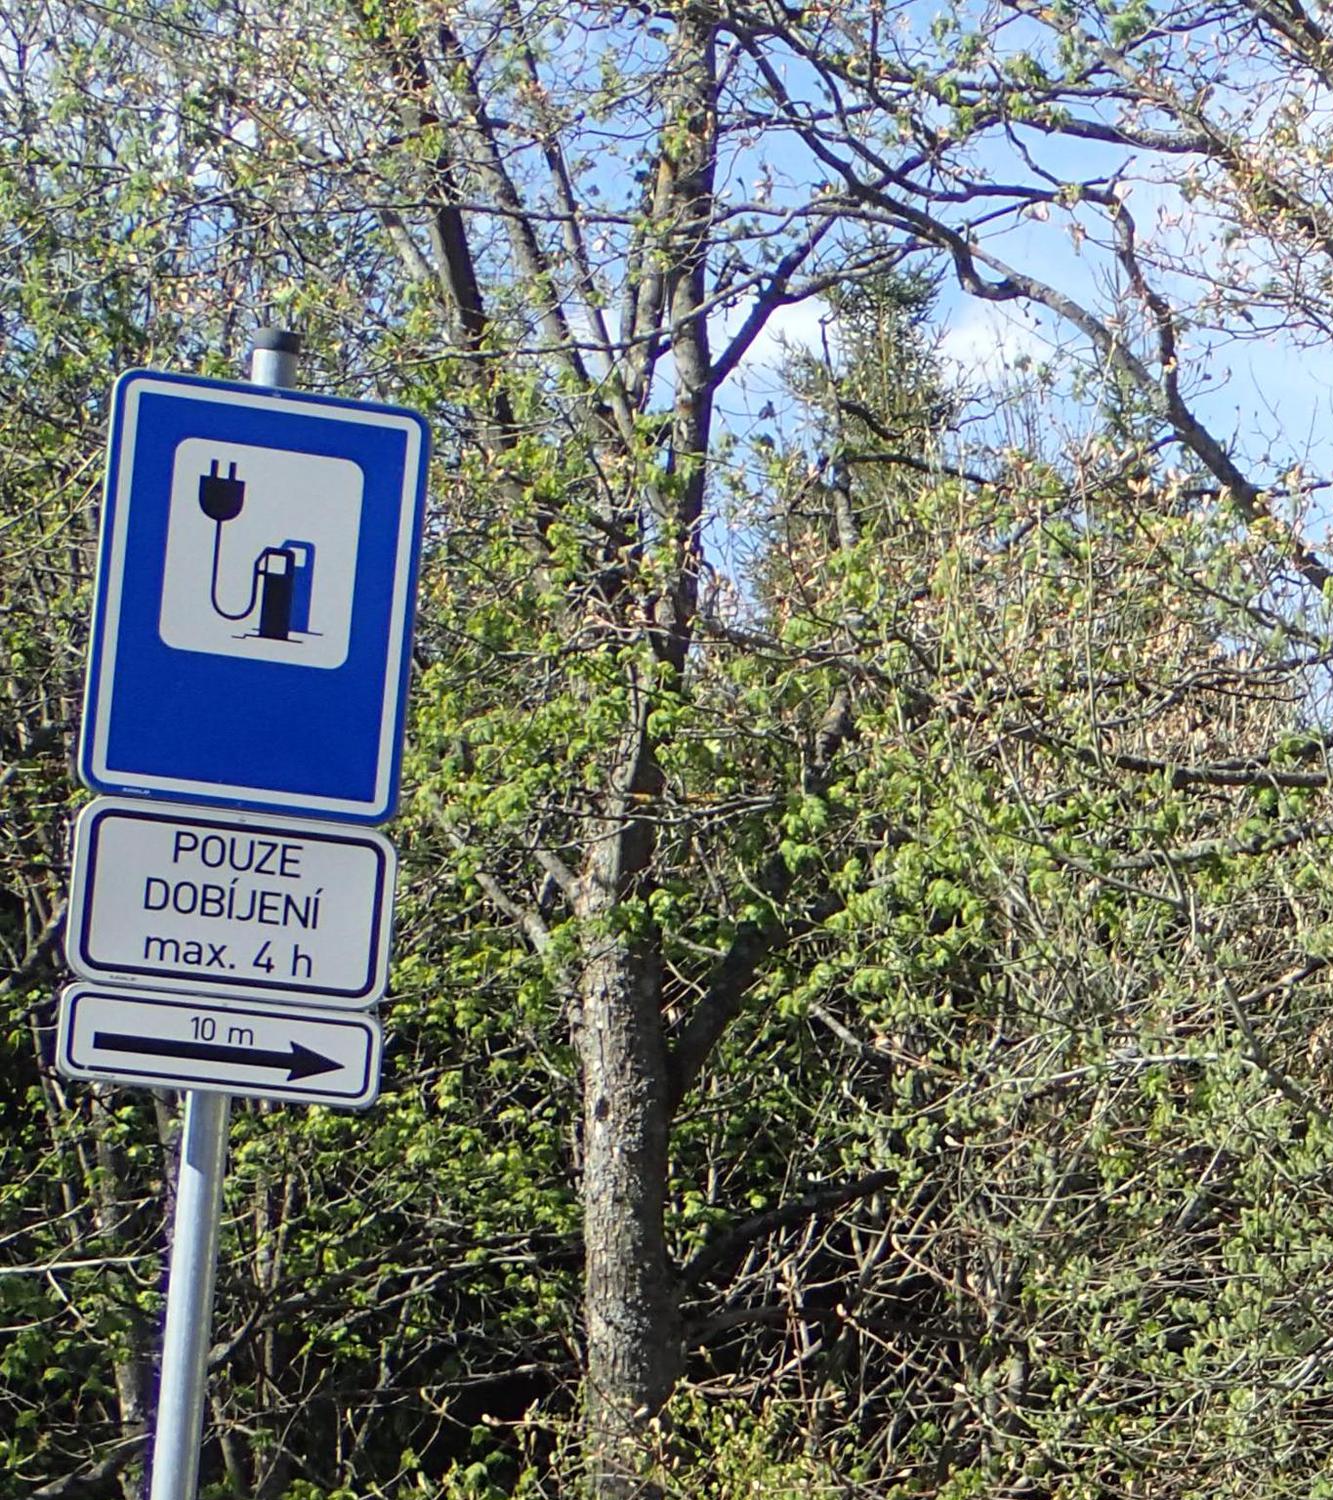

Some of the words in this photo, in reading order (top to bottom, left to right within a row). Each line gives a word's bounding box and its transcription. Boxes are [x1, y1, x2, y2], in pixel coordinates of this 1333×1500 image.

[172, 830, 304, 878] POUZE
[142, 877, 324, 930] DOBÍJENÍ
[143, 935, 237, 970] max.
[252, 941, 276, 974] 4
[291, 944, 314, 978] h
[190, 1016, 217, 1042] 10
[227, 1026, 255, 1046] m
